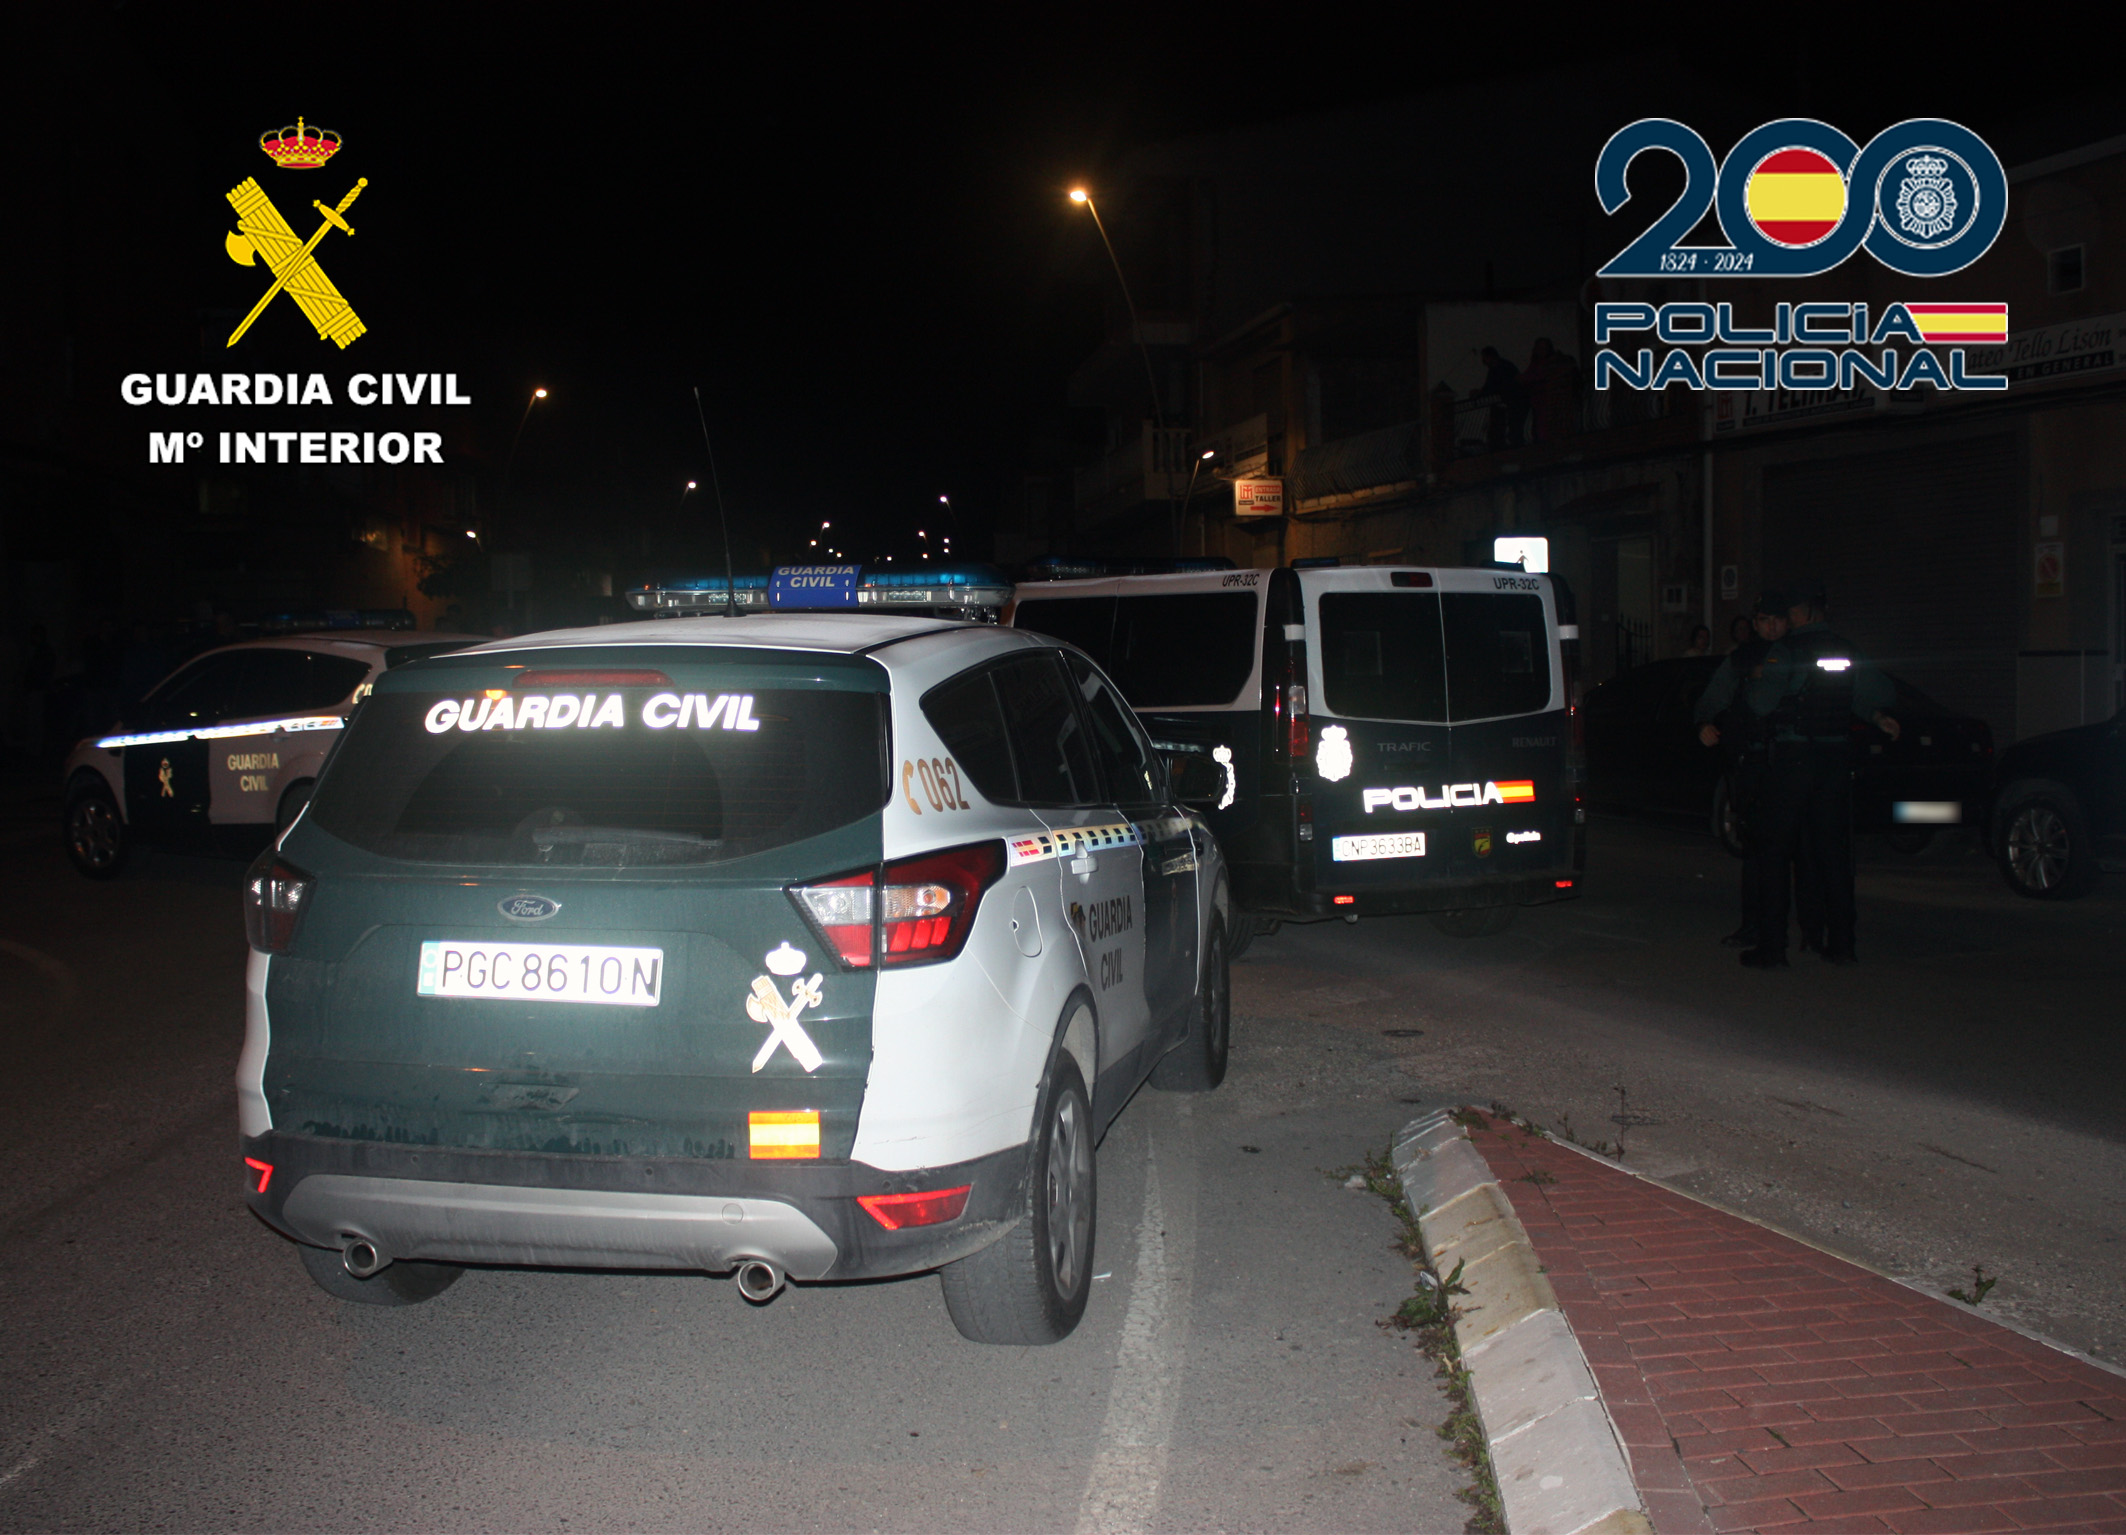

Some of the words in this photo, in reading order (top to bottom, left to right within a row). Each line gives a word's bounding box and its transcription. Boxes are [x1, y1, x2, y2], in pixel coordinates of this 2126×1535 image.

[1965, 345, 2004, 370] ateo
[2042, 353, 2111, 375] GENERAL
[777, 566, 855, 576] GUARDIA
[790, 576, 835, 588] CIVIL
[1222, 573, 1259, 587] UPR-32C
[1493, 577, 1541, 591] UPR-32C
[424, 694, 625, 734] GUARDIA
[642, 693, 761, 732] CIVIL
[1376, 741, 1432, 752] TRAFIC
[1511, 736, 1558, 748] RENAULT
[227, 753, 279, 771] GUARDIA
[240, 775, 268, 792] CIVIL
[920, 757, 971, 813] 062
[1362, 781, 1504, 815] POLICIA
[510, 899, 545, 916] Ford
[1088, 895, 1133, 943] GUARDIA
[1100, 948, 1123, 992] CIVIL
